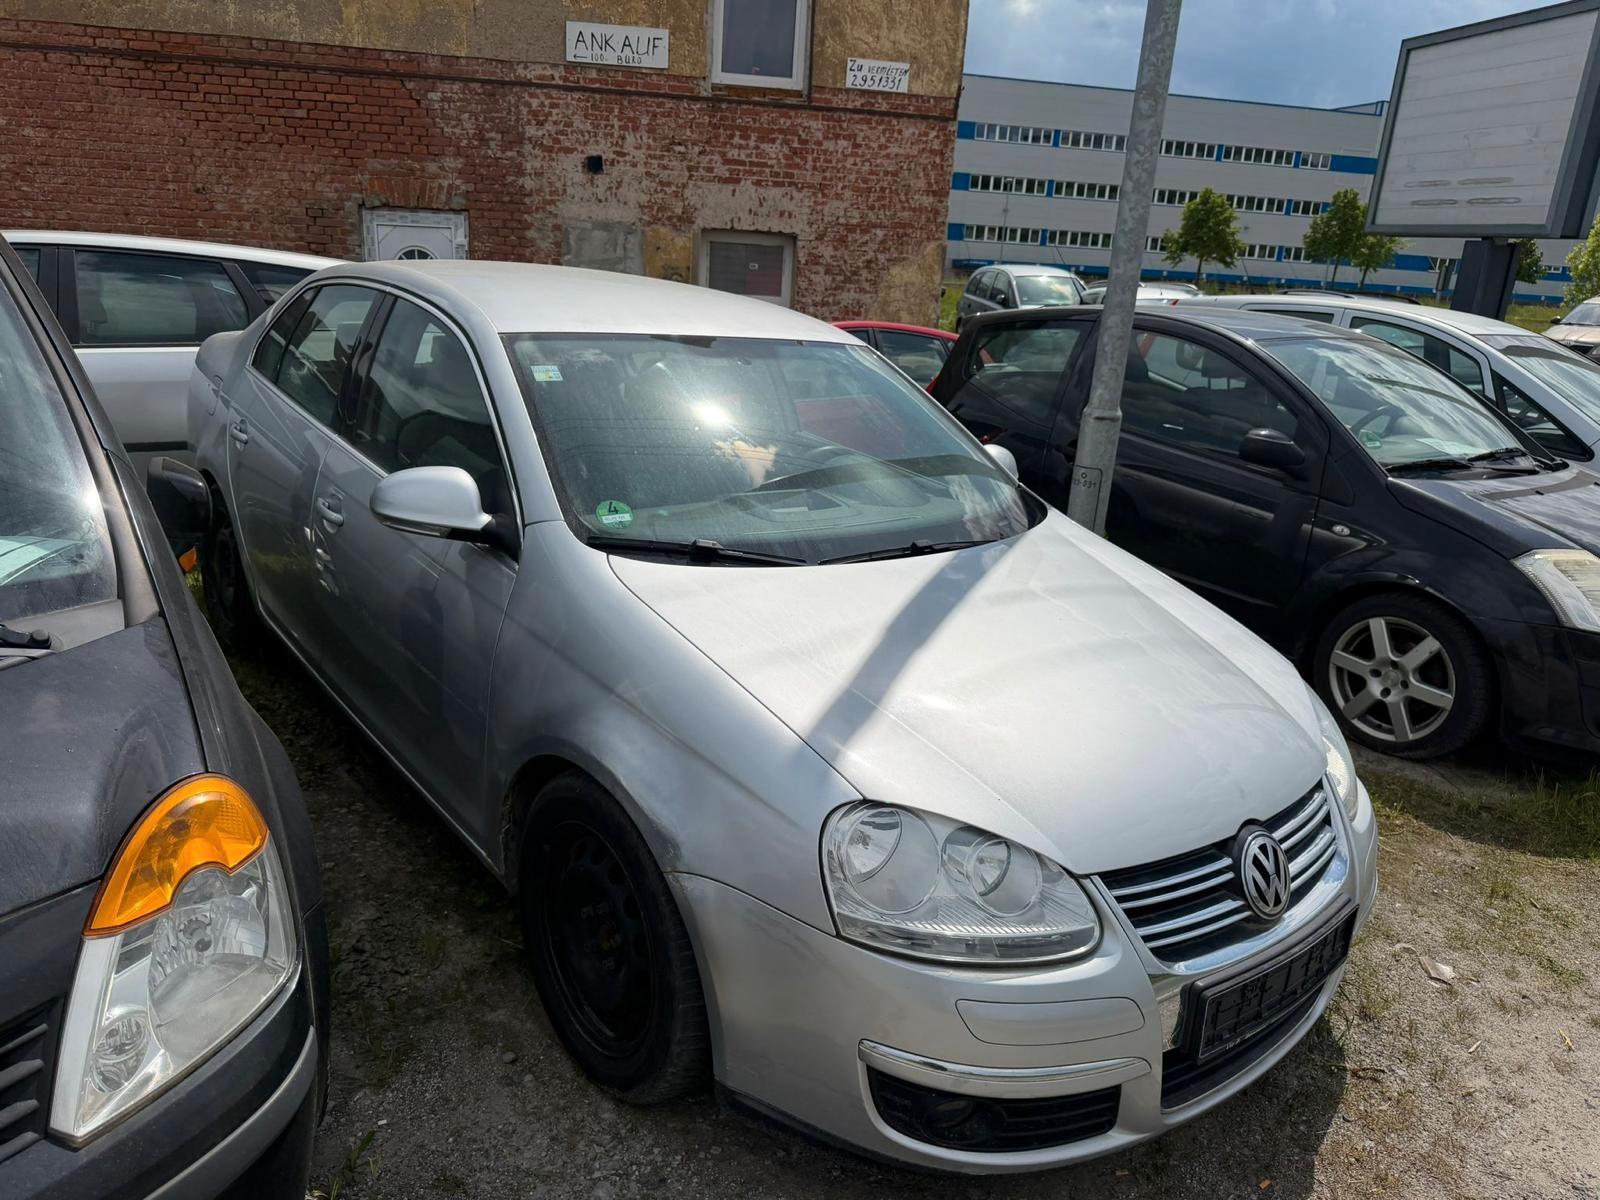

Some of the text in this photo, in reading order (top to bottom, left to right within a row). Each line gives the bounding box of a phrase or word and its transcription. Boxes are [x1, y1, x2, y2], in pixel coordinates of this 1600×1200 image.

[851, 74, 902, 91] 2951331
[608, 501, 618, 514] 4
[1245, 837, 1286, 911] VW
